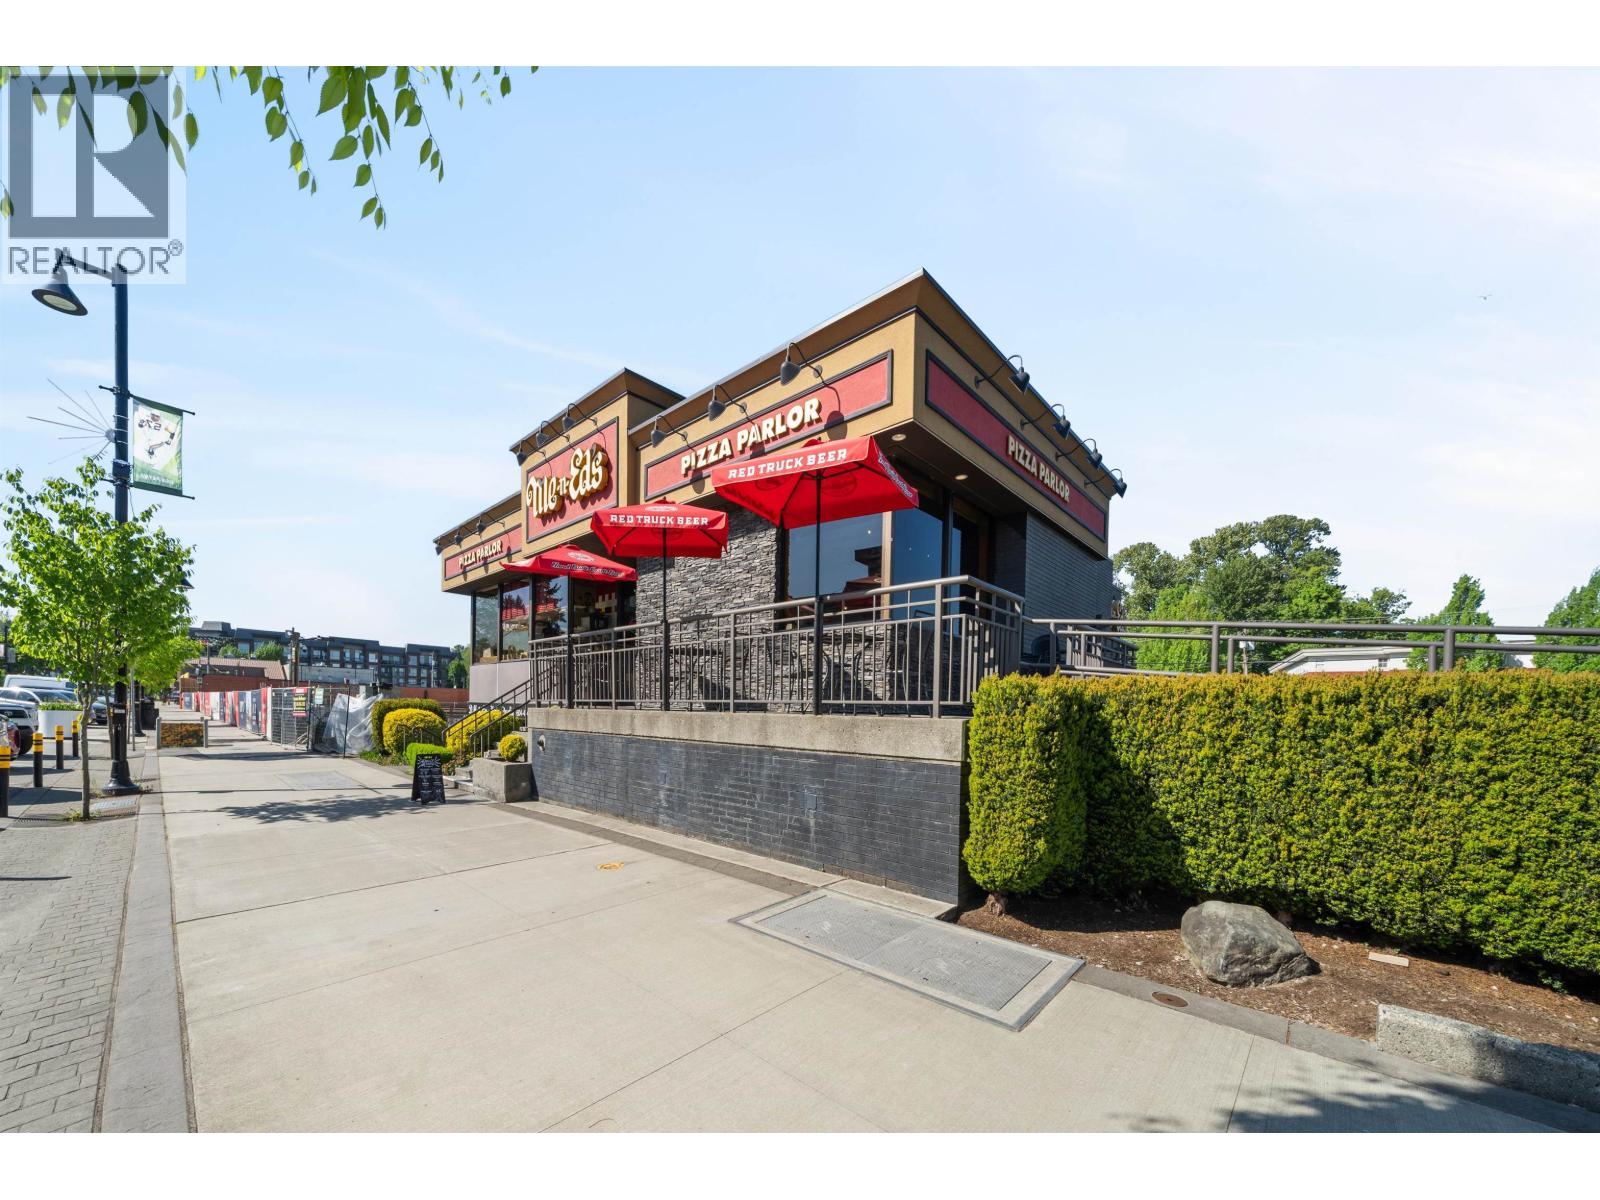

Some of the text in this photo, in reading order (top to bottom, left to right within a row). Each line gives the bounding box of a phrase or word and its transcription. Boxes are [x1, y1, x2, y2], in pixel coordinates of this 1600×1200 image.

[680, 399, 820, 475] PIZZA PARLOR
[728, 448, 848, 480] RED TRUCK BEER
[1008, 434, 1070, 503] PIZZA PARLOR
[610, 514, 709, 526] RED TRUCK BEER
[458, 540, 502, 568] PIZZA PARLOR
